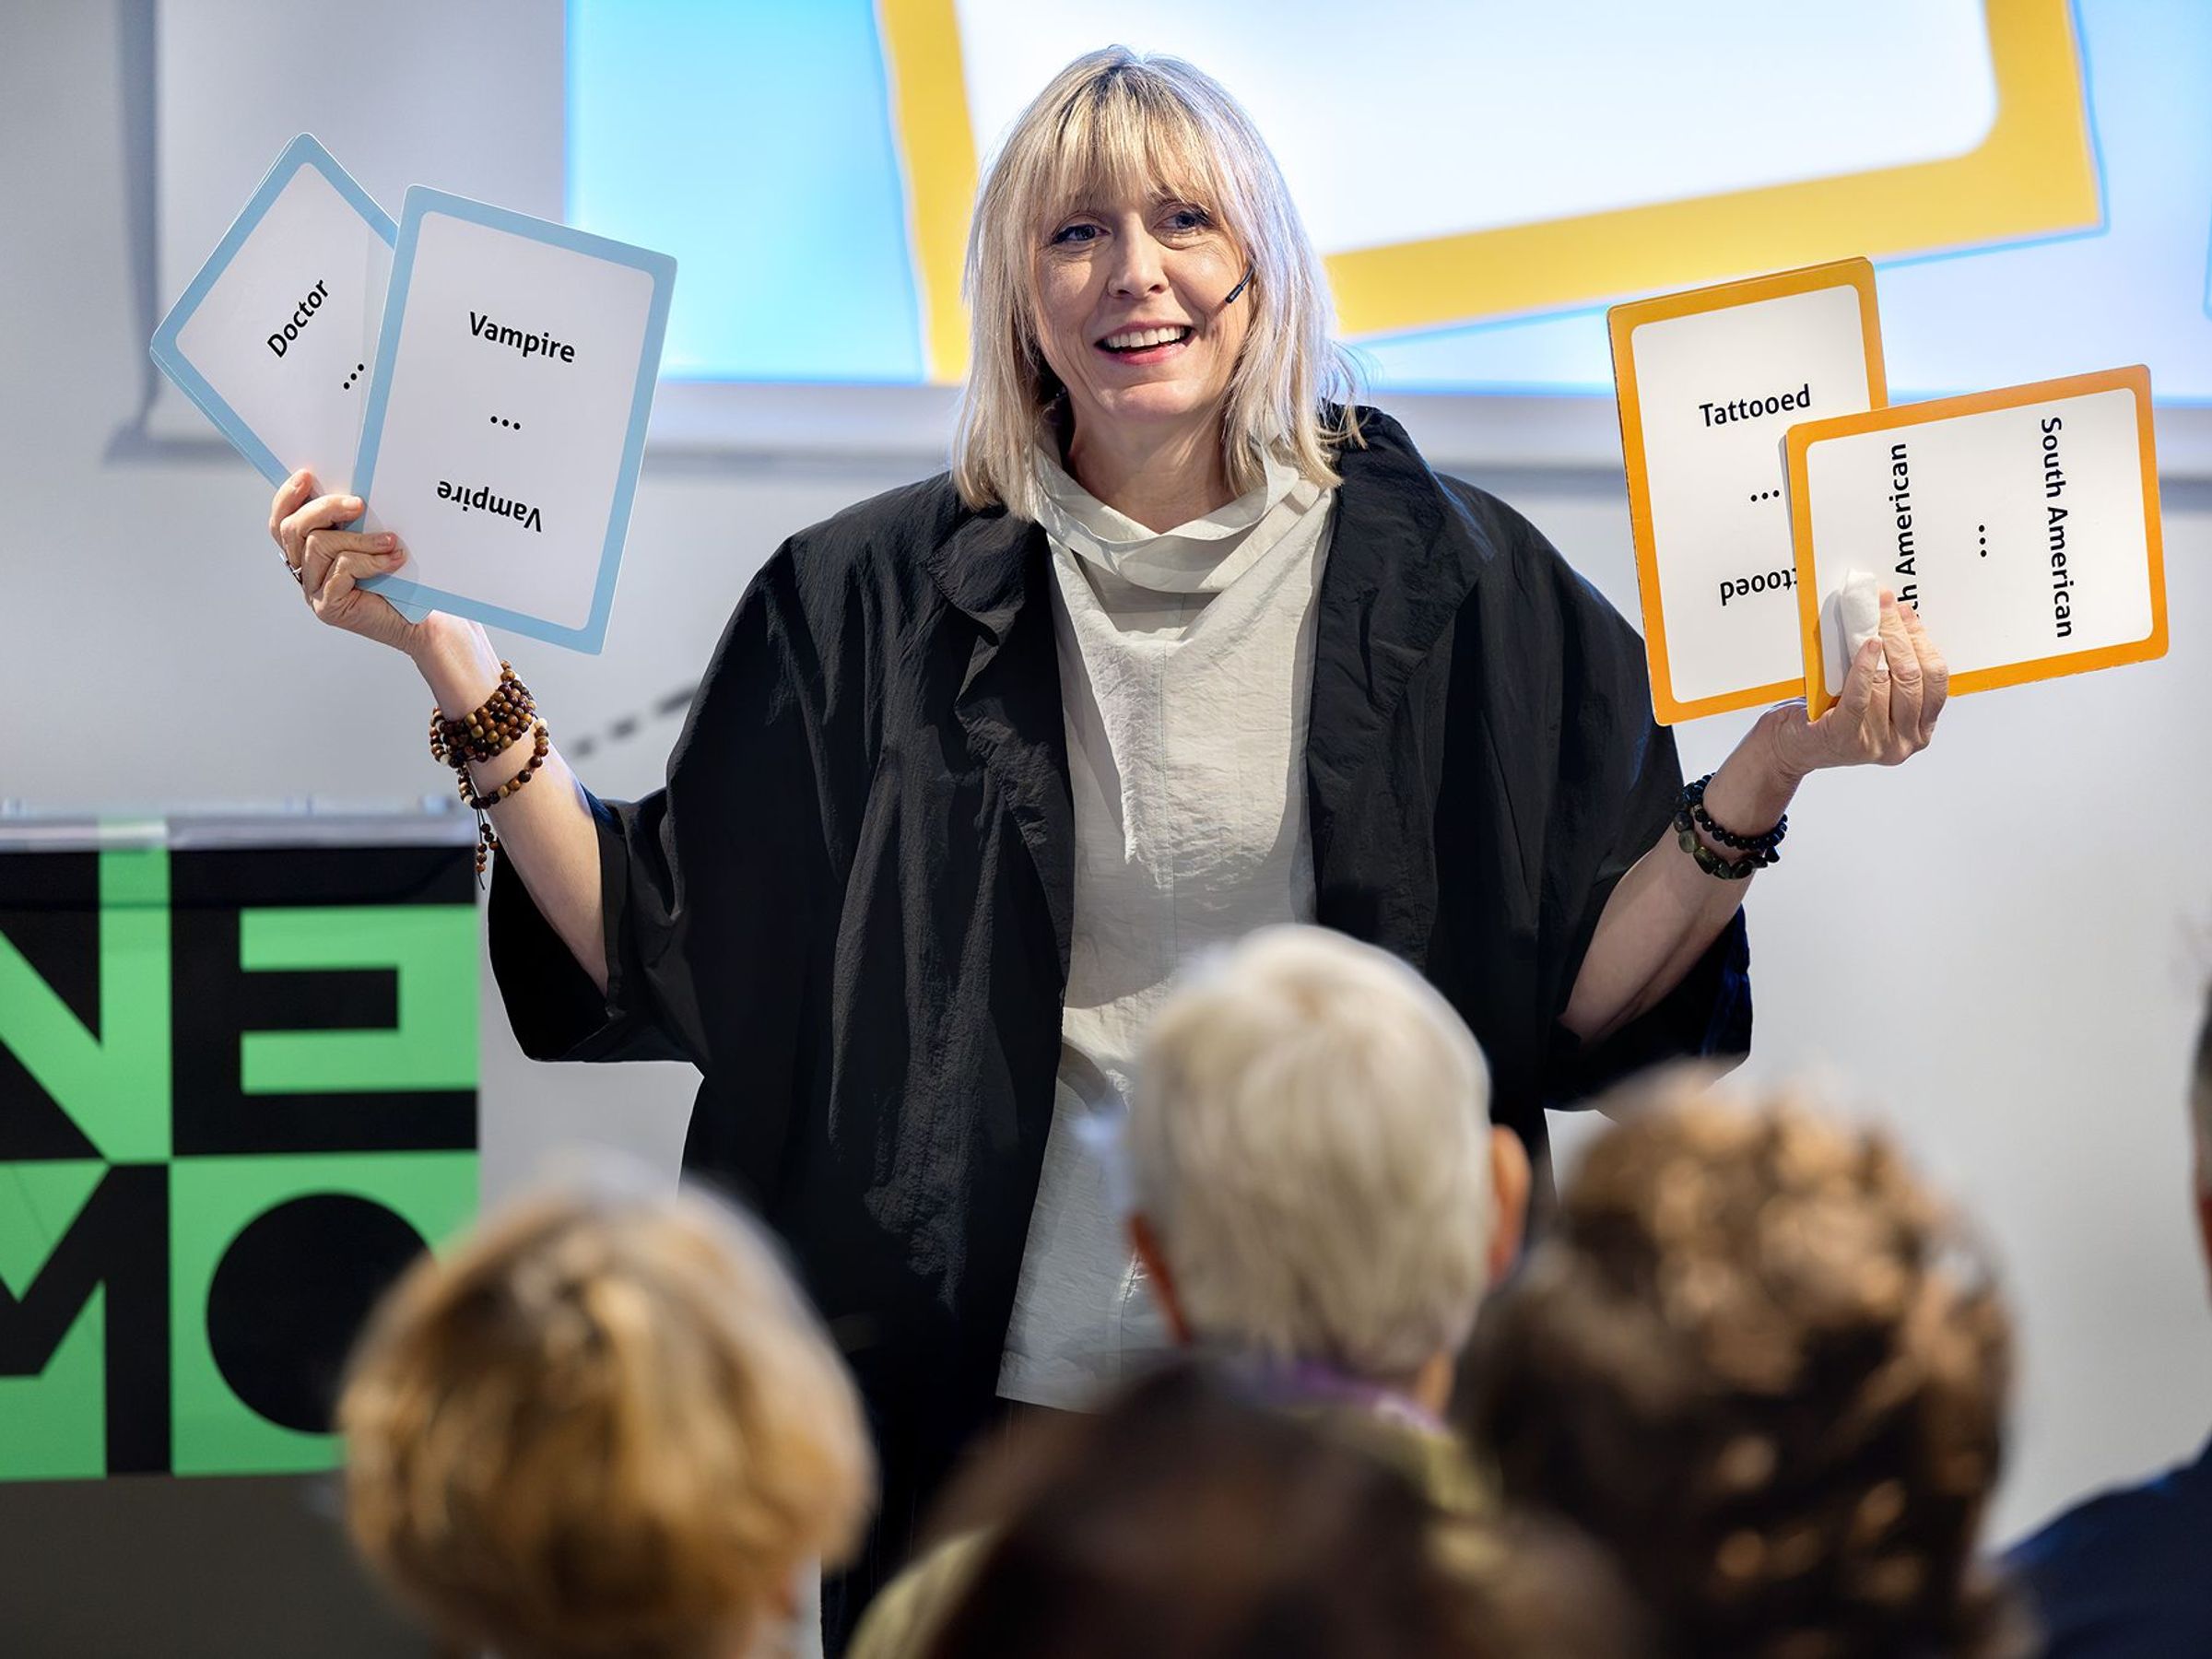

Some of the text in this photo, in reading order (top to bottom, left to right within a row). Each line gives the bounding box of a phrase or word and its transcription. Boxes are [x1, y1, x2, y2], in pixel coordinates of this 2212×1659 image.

[266, 279, 329, 359] Doctor
[469, 311, 575, 363] Vampire
[1699, 383, 1811, 428] Tattooed
[437, 480, 542, 533] Vampire
[1888, 443, 1916, 576] American
[2041, 417, 2075, 638] South American
[1720, 567, 1797, 606] tooed
